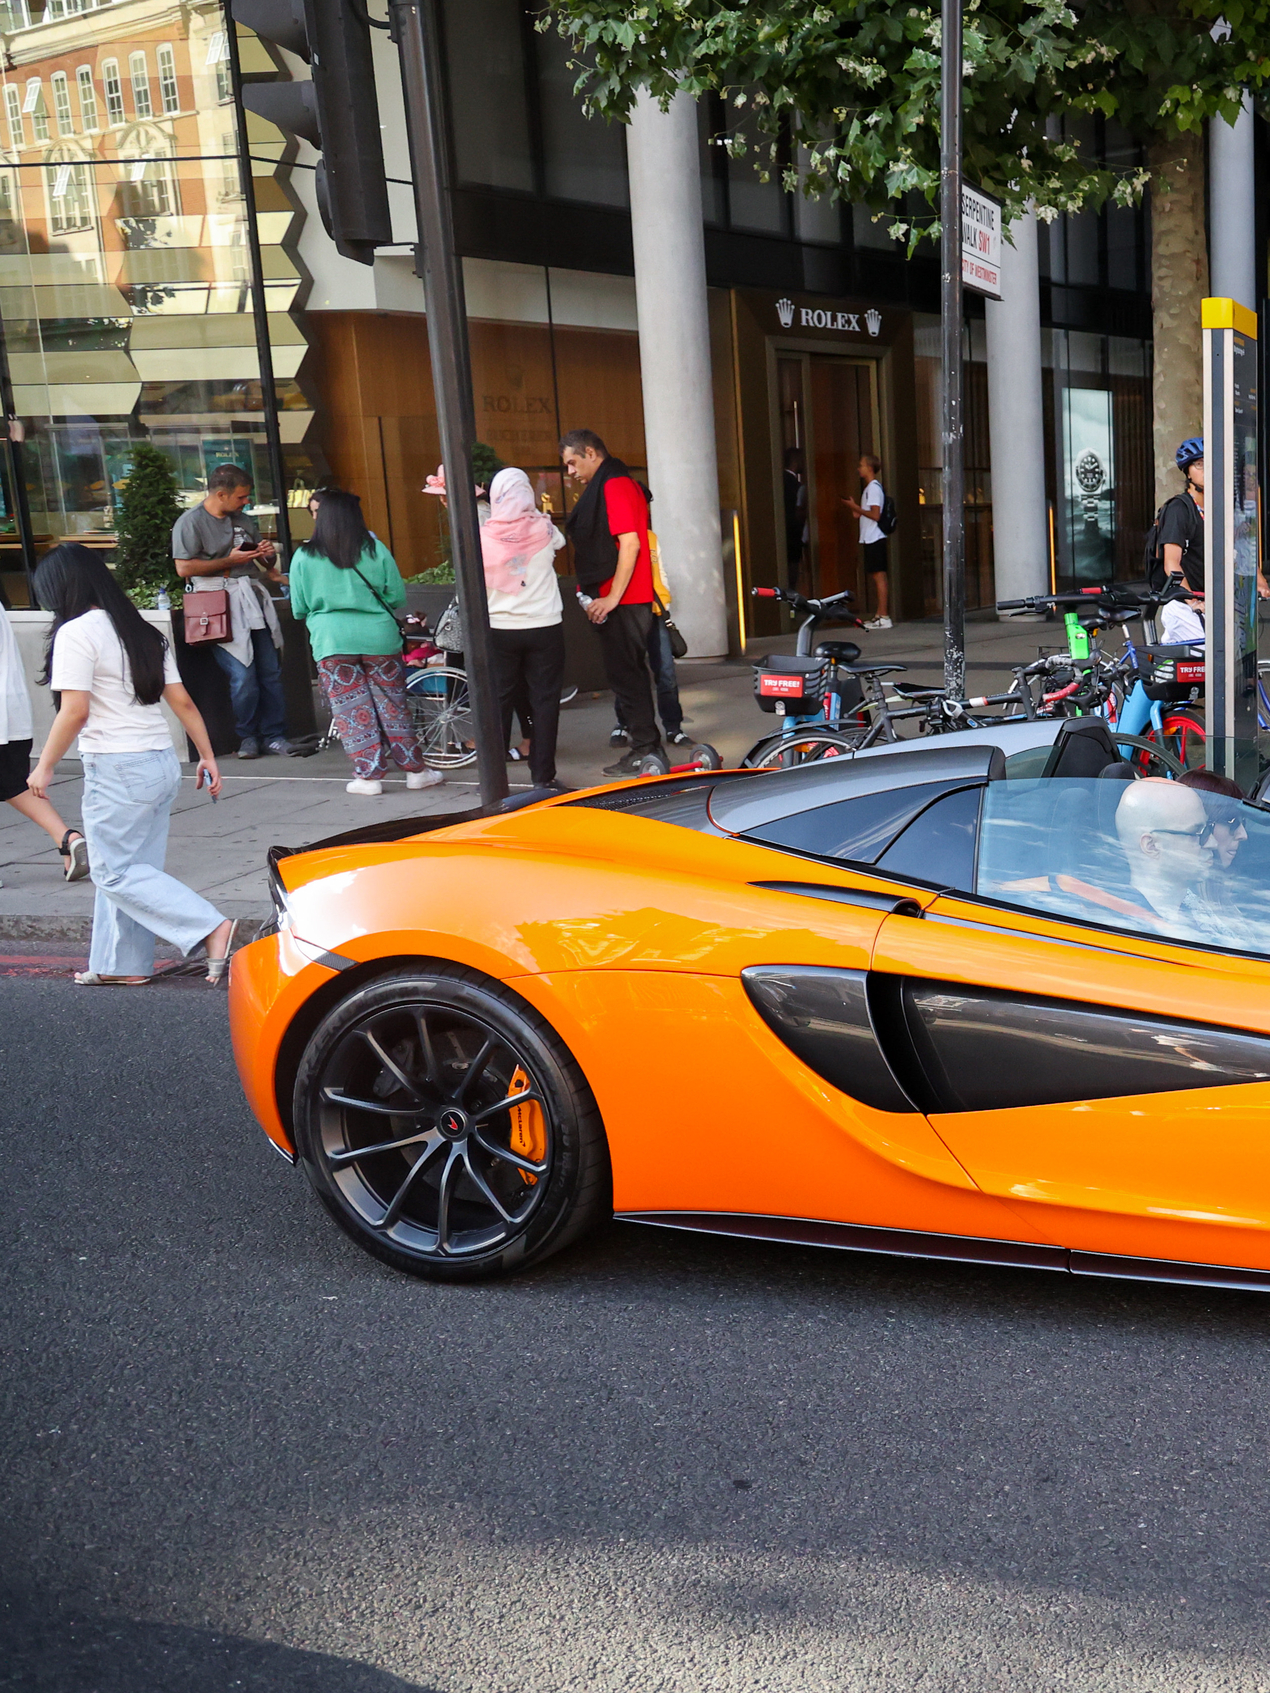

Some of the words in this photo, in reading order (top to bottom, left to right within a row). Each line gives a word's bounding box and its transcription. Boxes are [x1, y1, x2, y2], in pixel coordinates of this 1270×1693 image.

[962, 193, 994, 231] SERPENTINE
[975, 265, 997, 285] WESTMINSTER
[800, 307, 861, 332] ROLEX
[482, 395, 552, 414] ROLEX
[764, 679, 778, 687] TRY
[778, 680, 800, 688] FREE!
